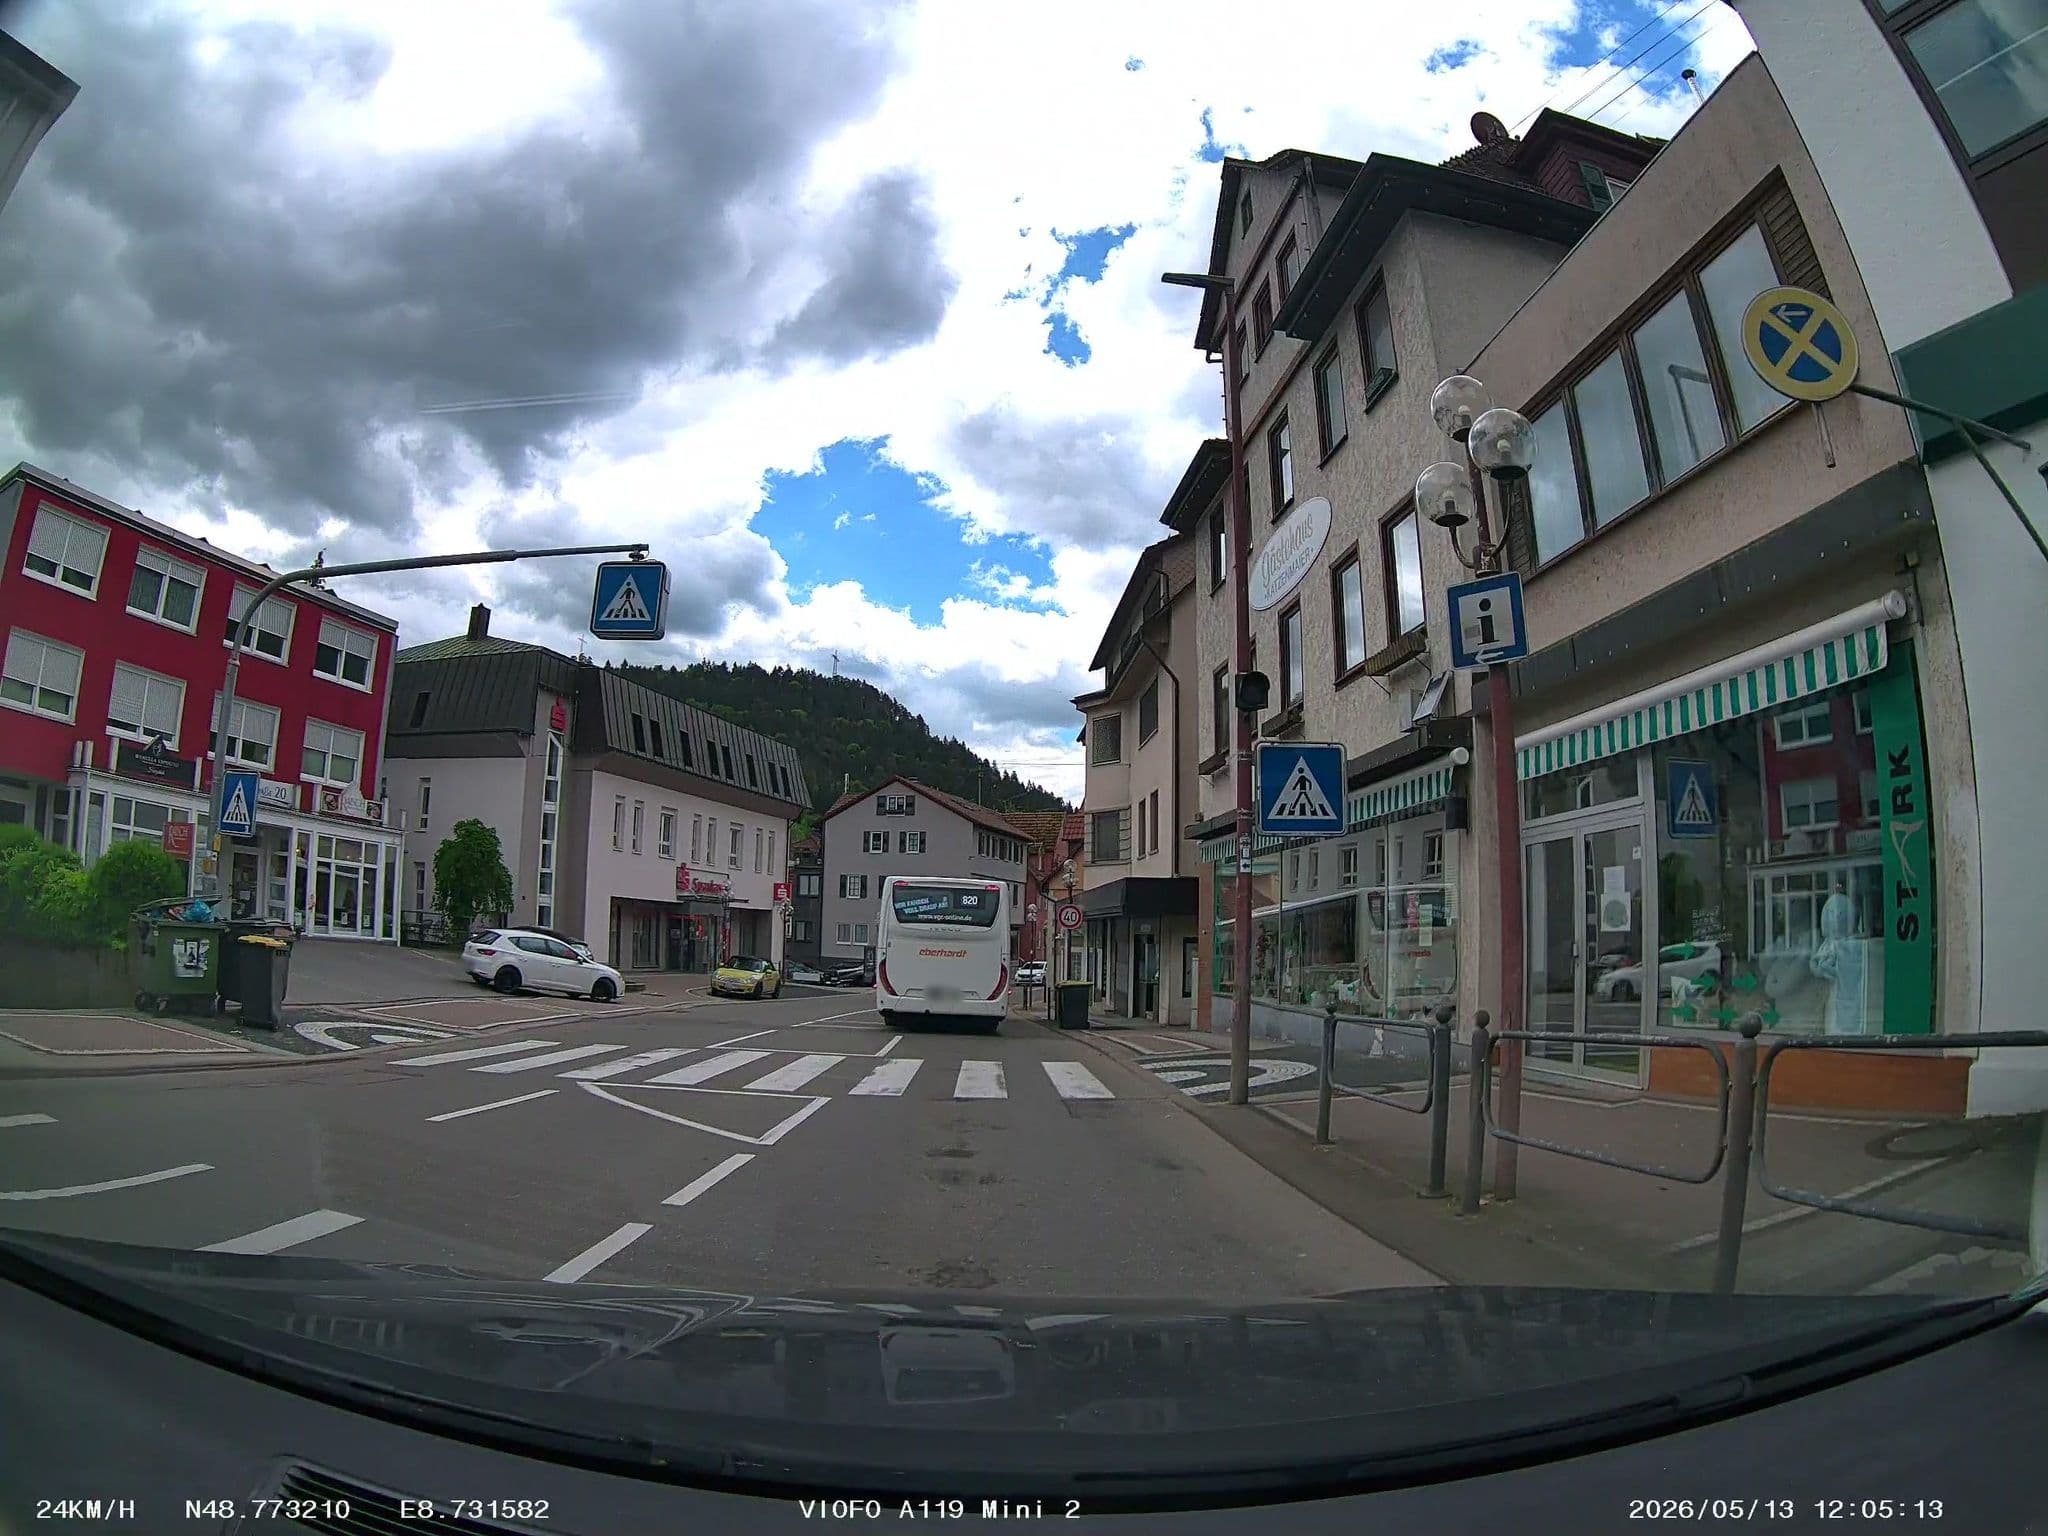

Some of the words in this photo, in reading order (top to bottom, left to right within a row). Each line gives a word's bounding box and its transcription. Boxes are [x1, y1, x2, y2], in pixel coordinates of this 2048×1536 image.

[1261, 513, 1314, 588] Gästehaus
[274, 786, 287, 800] 20
[962, 895, 978, 905] 820
[1064, 911, 1077, 921] 40
[919, 948, 967, 958] eberhardt
